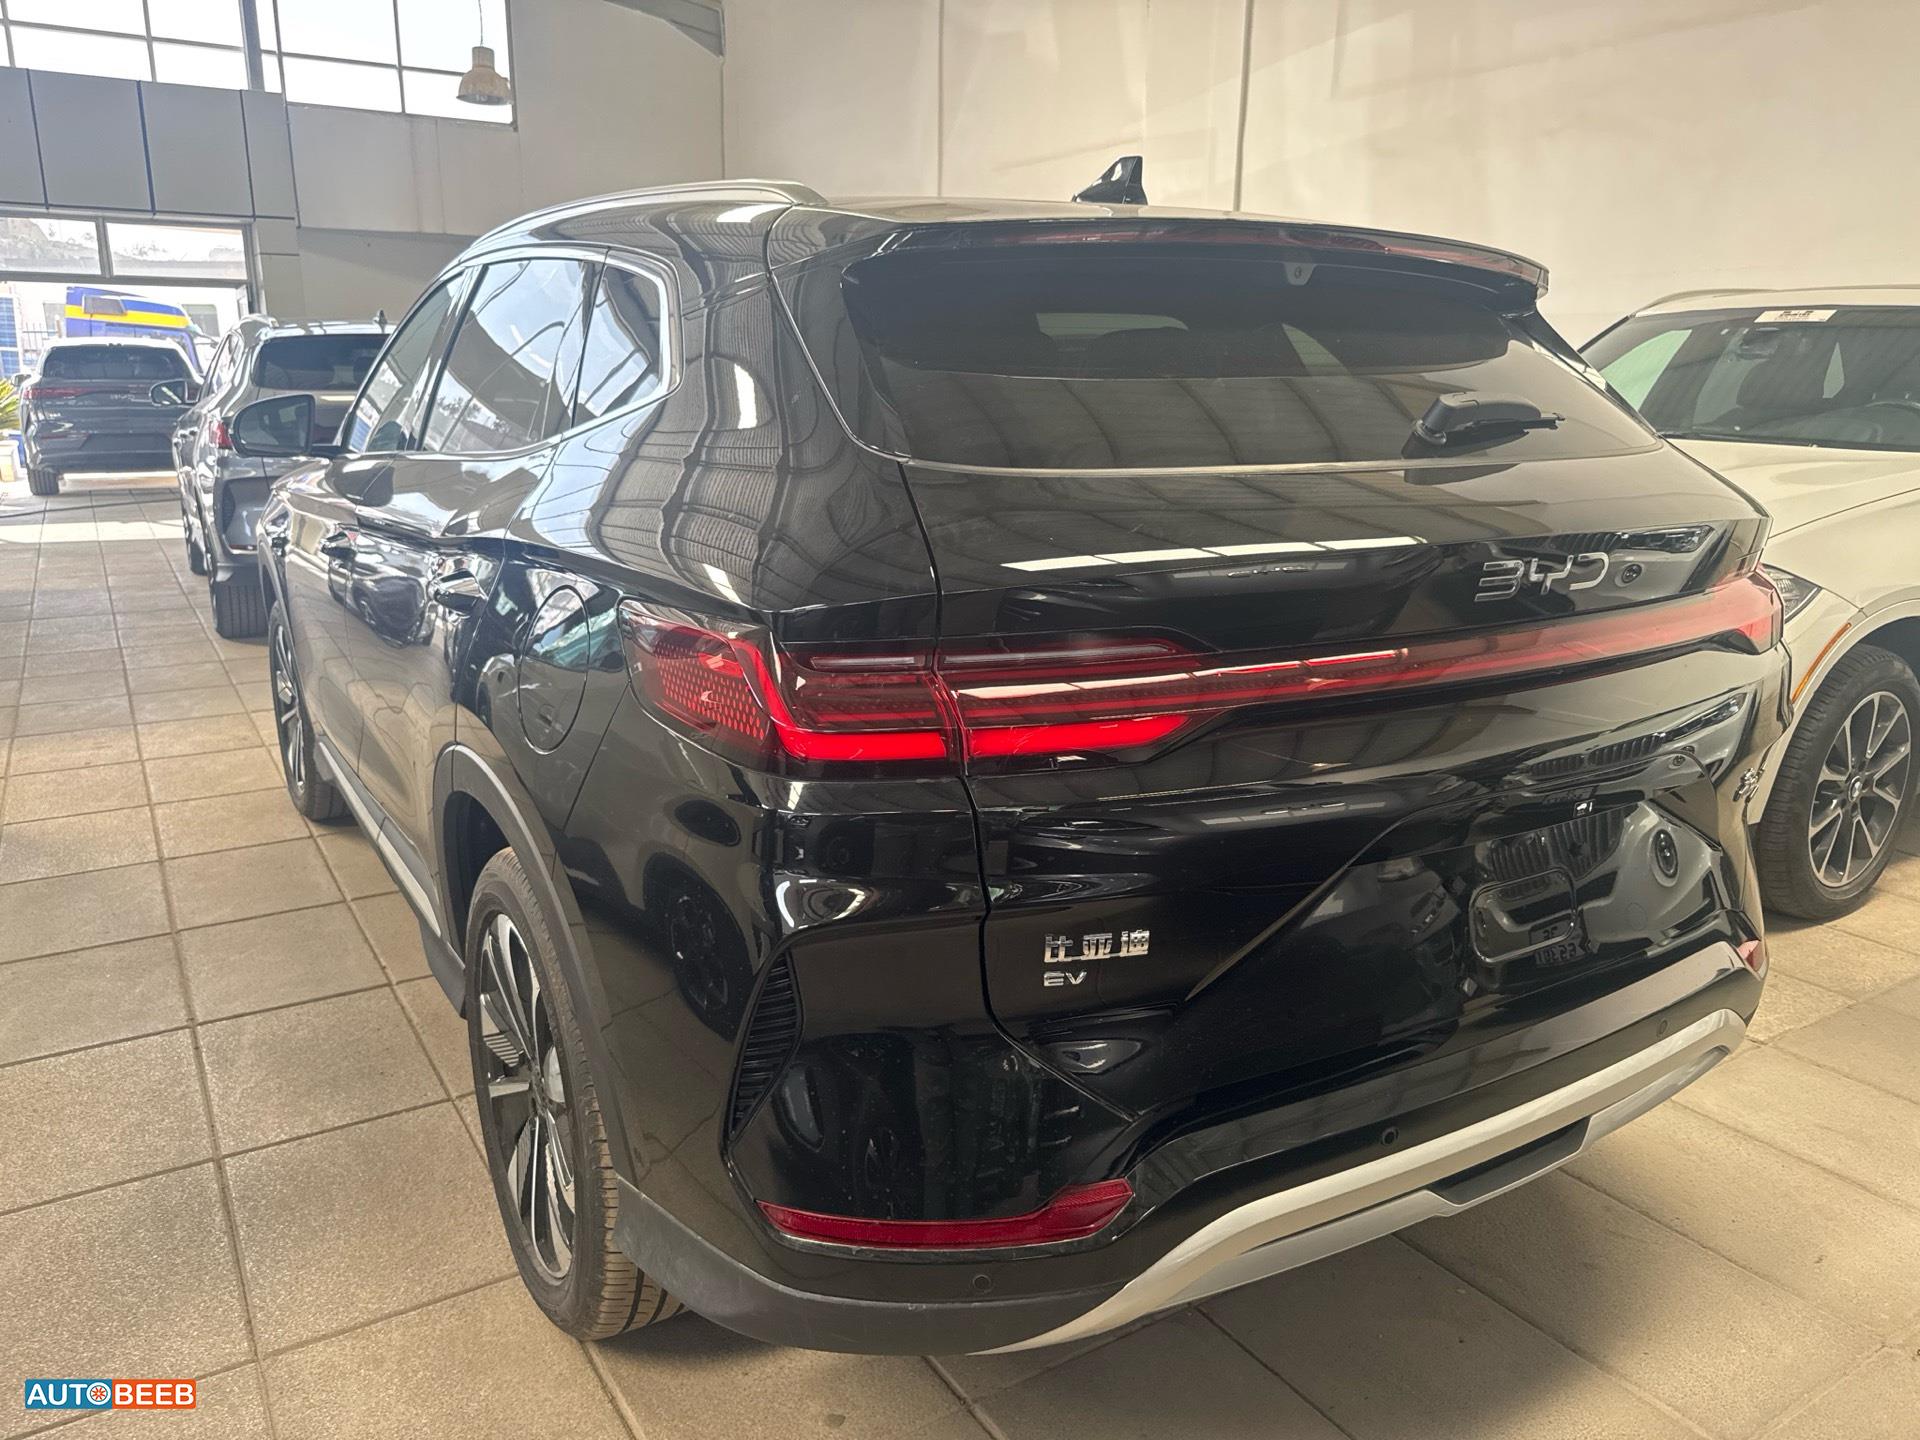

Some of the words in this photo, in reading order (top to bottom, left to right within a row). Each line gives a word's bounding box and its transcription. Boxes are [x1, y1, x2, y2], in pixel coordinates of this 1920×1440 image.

[1474, 551, 1609, 602] BYD
[1044, 929, 1150, 963] 比亚迪
[1042, 970, 1087, 987] EV
